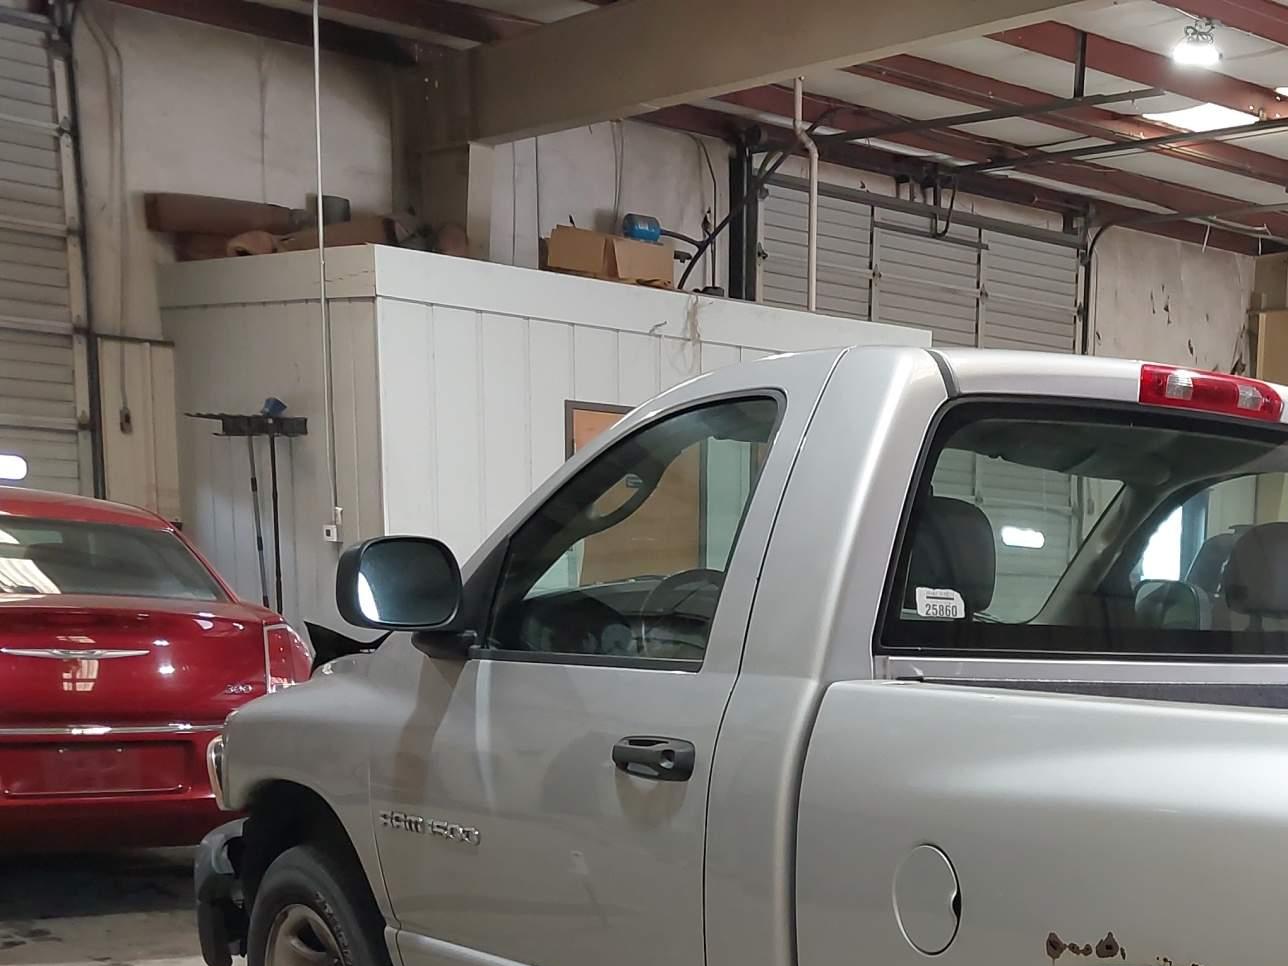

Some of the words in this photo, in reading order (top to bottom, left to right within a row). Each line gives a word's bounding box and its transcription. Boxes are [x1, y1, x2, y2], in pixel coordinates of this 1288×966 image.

[925, 603, 958, 617] 25860
[224, 684, 253, 694] 300
[427, 820, 481, 846] 1500
